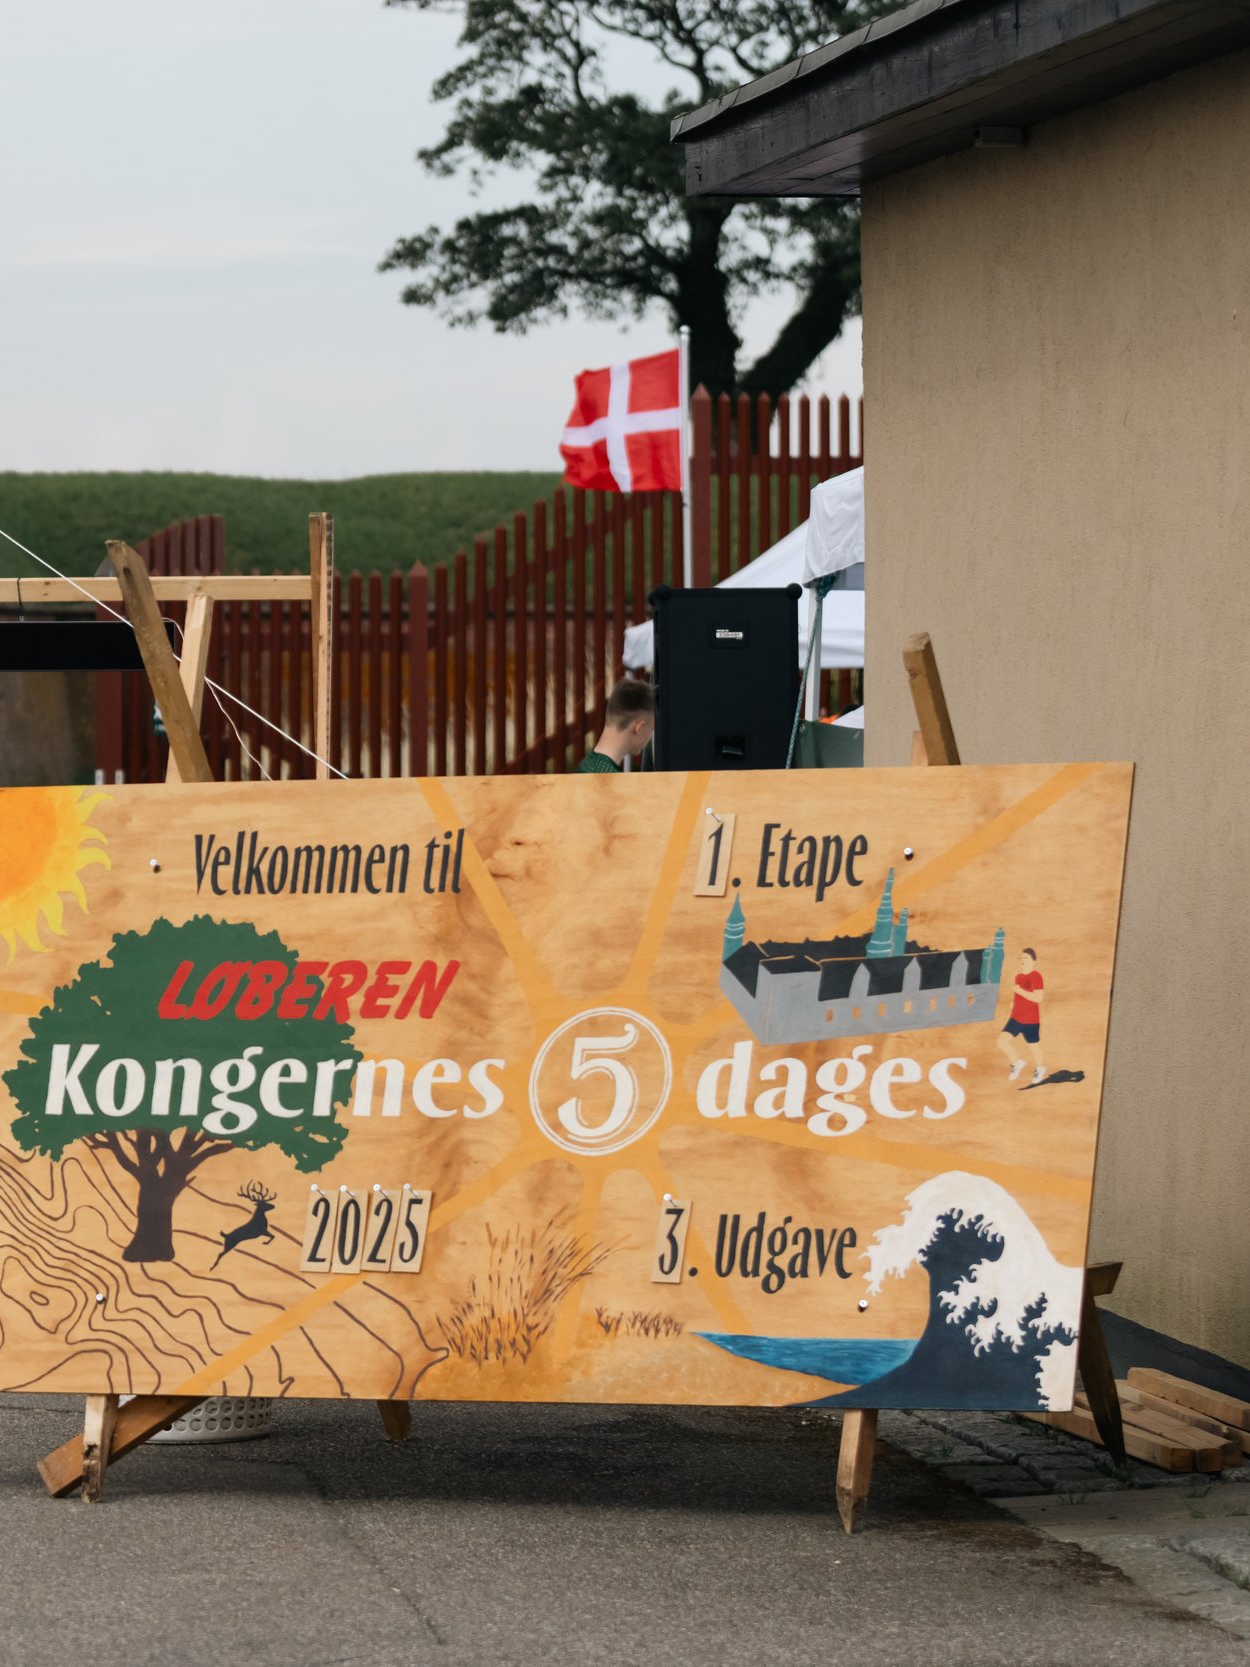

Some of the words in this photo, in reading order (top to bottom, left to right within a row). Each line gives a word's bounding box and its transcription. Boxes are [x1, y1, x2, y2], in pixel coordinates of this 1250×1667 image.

[194, 830, 410, 896] Velkommen
[422, 828, 466, 894] til
[707, 822, 741, 888] 1.
[756, 823, 868, 903] Etape
[157, 959, 460, 1025] LØBEREN
[44, 1043, 506, 1136] Kongernes
[557, 1023, 639, 1144] 5
[696, 1040, 968, 1137] dages
[306, 1197, 424, 1266] 2025
[658, 1208, 698, 1277] 3.
[714, 1211, 857, 1294] Udgave
